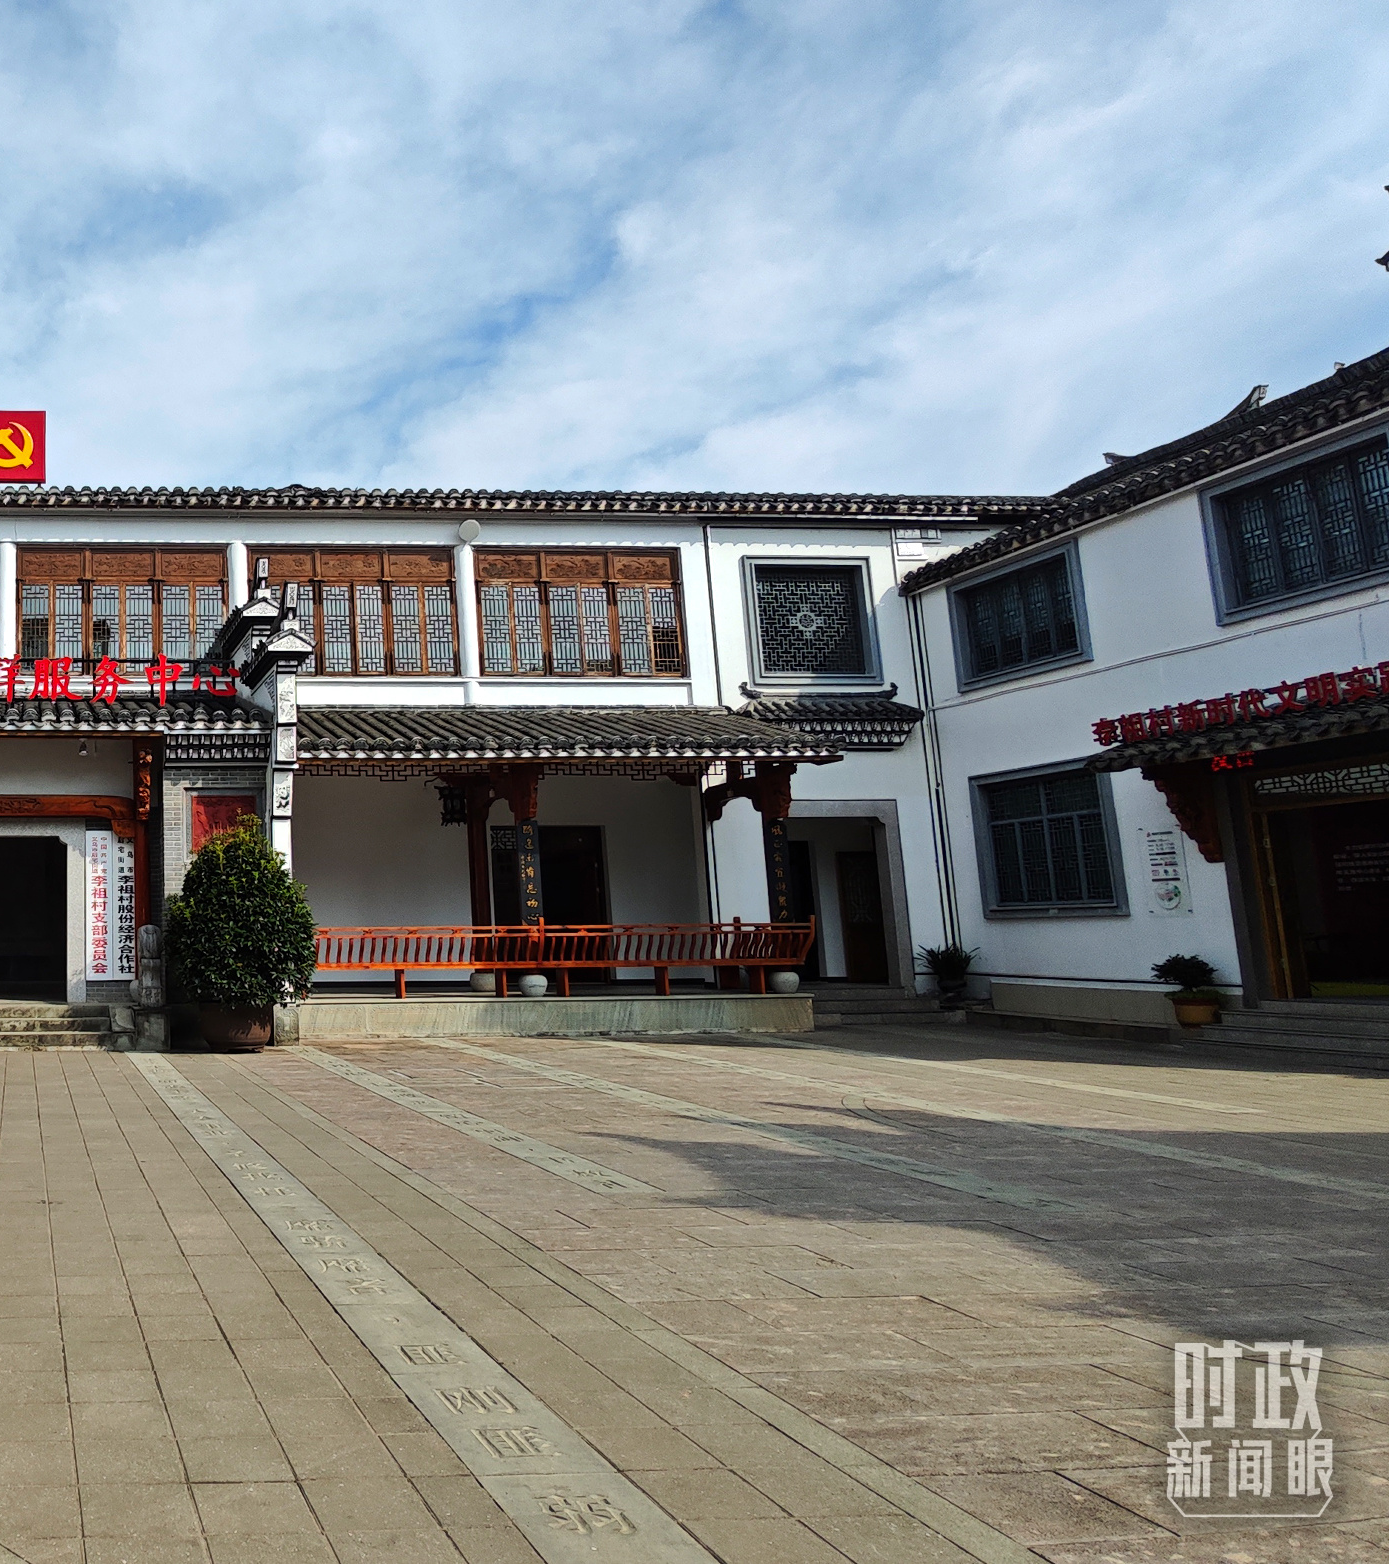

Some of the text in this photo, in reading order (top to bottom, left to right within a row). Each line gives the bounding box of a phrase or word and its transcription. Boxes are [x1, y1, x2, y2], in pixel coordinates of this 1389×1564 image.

[91, 875, 108, 974] 李祖村支部委员会
[117, 875, 135, 974] 李祖村股份经济合作社
